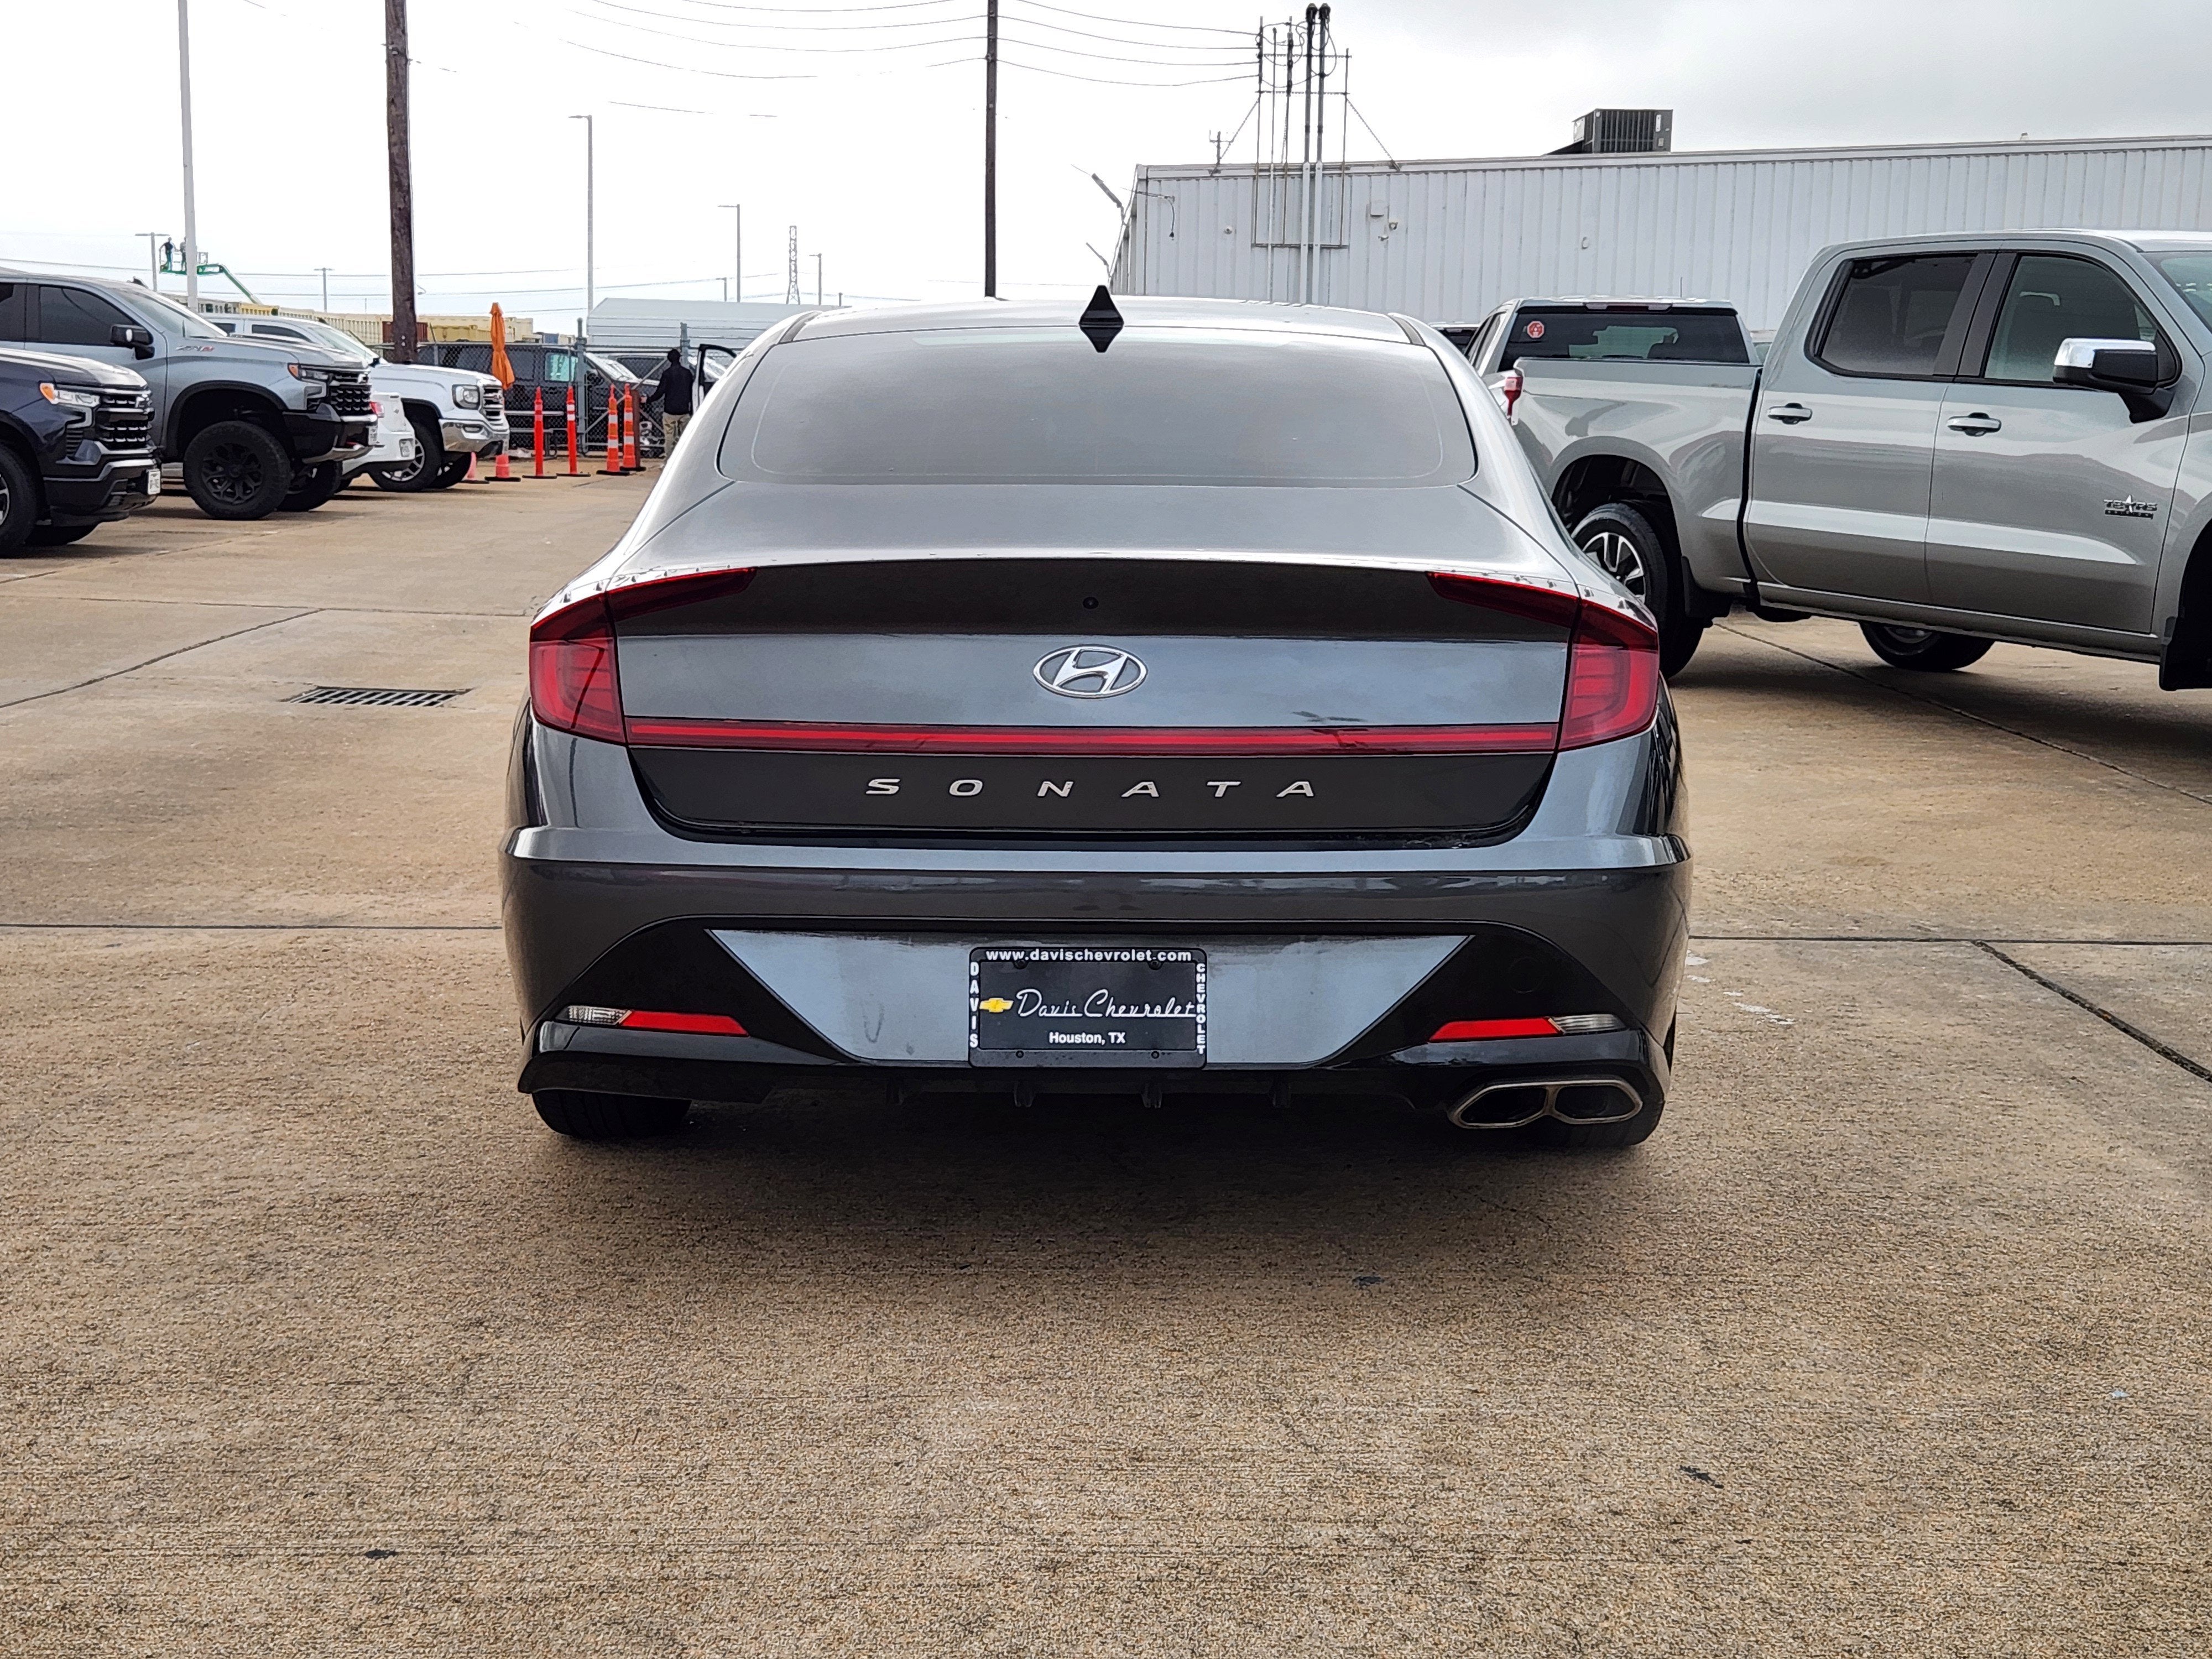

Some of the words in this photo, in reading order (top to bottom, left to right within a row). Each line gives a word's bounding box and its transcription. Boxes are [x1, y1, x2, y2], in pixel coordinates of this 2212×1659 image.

[866, 778, 1314, 797] SONATA
[985, 948, 1192, 961] www.davischevrolet.com
[969, 961, 979, 1048] DAVIS
[1016, 989, 1083, 1017] Davis
[1084, 989, 1197, 1017] Chevrolet
[1196, 963, 1206, 1054] CHEVROLET
[1049, 1031, 1105, 1045] Houston,
[1108, 1032, 1126, 1044] TX
